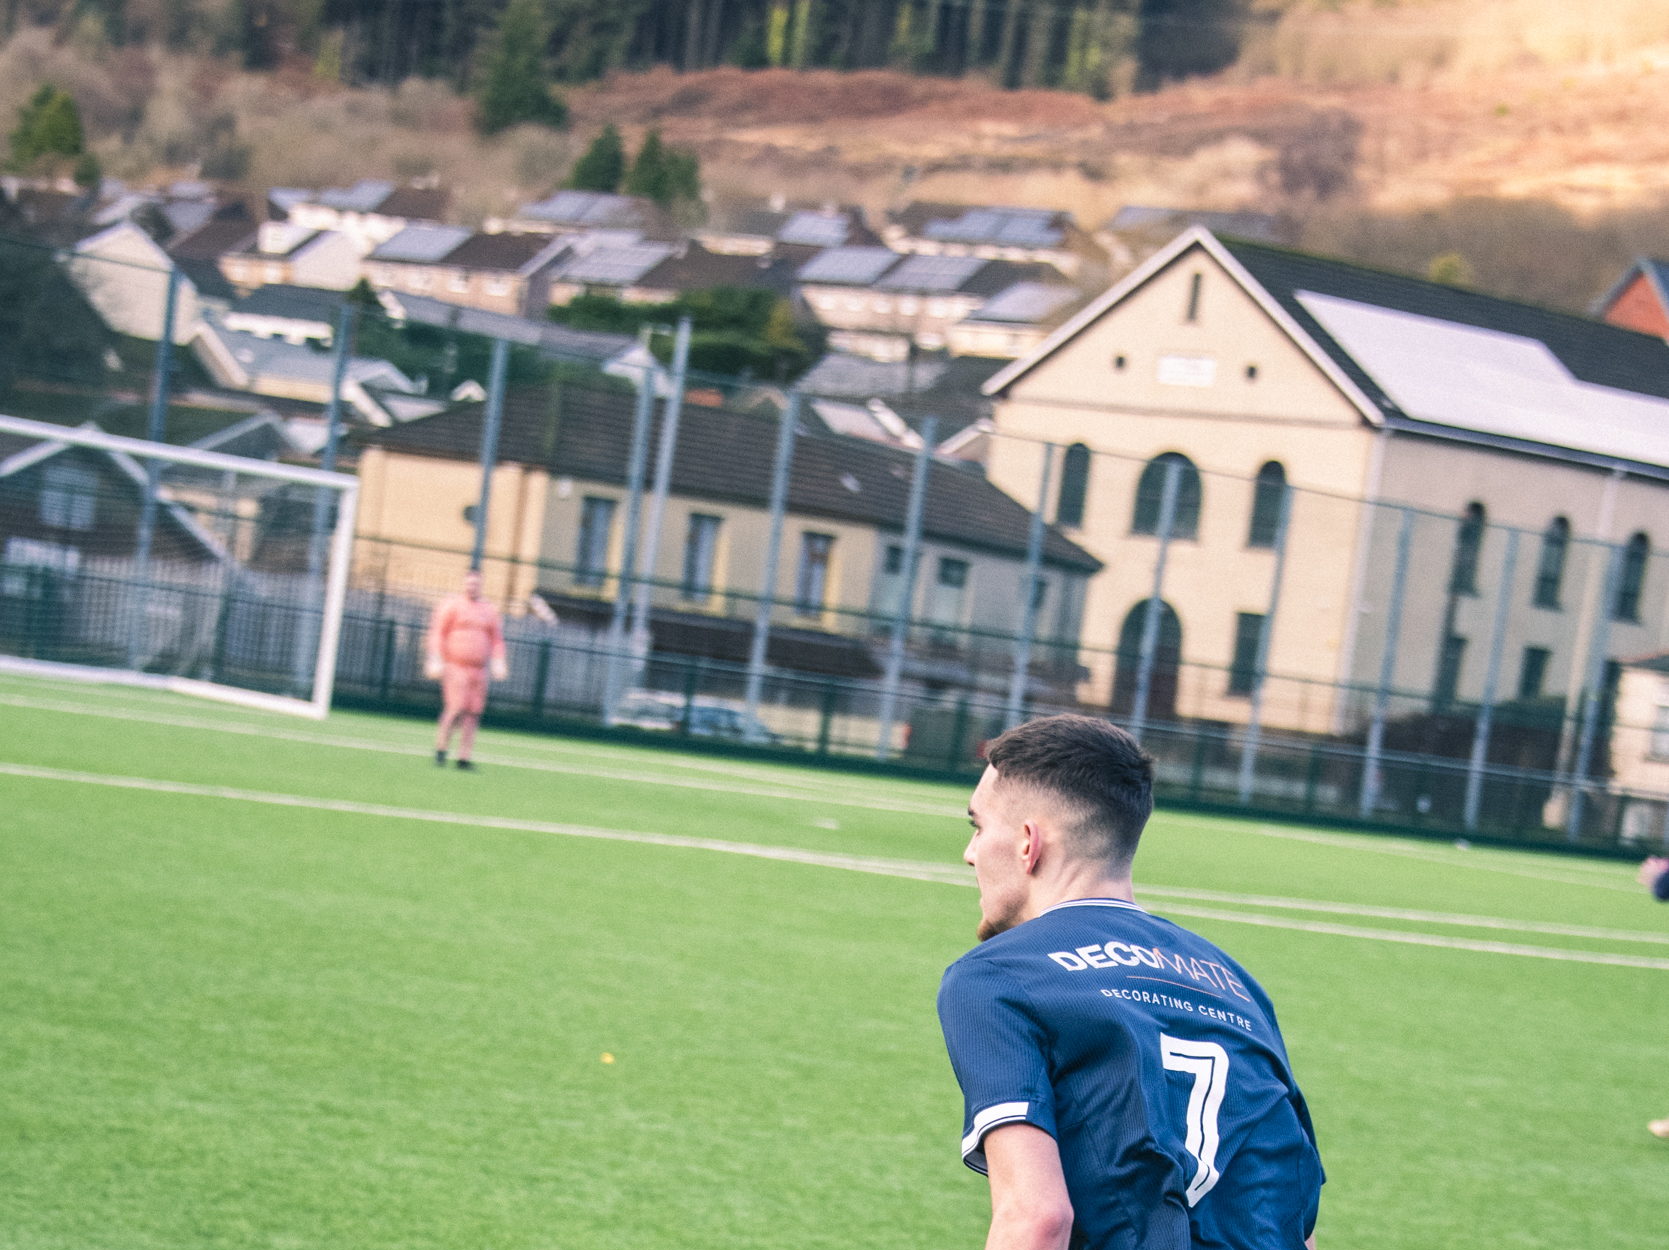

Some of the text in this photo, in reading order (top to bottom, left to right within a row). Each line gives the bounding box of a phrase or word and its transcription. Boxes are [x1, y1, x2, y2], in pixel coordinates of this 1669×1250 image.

[1047, 941, 1251, 1003] DECOMATE
[1100, 988, 1253, 1032] DECORATING CENTRE
[1160, 1031, 1230, 1209] 7
